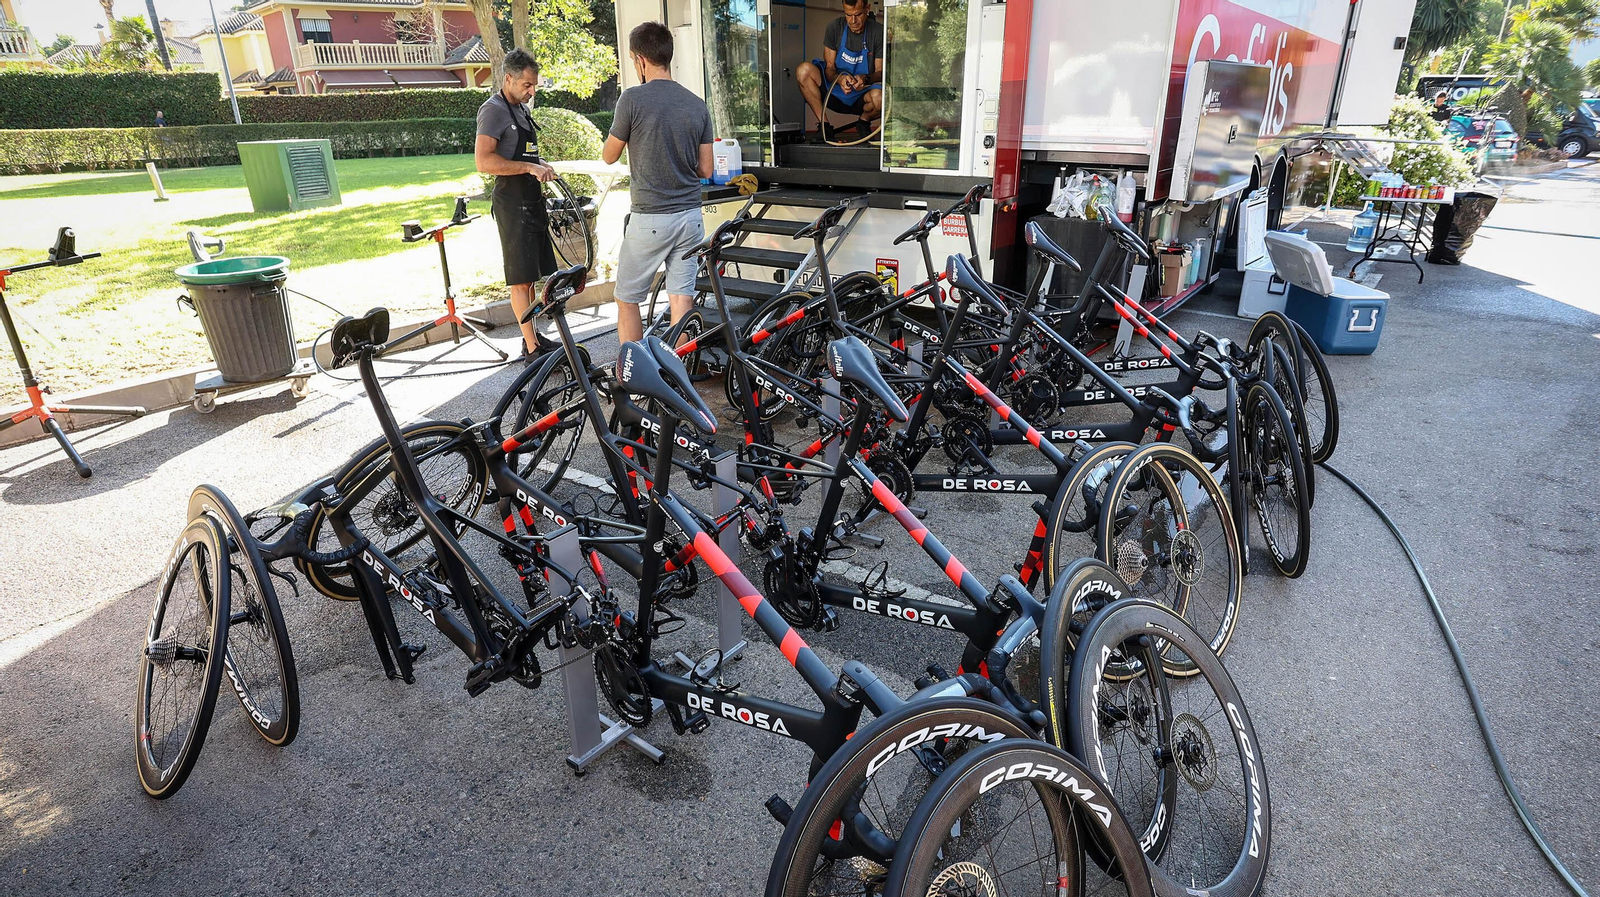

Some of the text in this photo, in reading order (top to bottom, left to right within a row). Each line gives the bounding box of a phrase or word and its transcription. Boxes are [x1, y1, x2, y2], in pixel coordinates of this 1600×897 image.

[704, 204, 717, 214] 903
[904, 321, 942, 344] DE RO
[1104, 357, 1172, 371] DE ROSA
[755, 375, 773, 391] DE
[1084, 390, 1105, 401] DE
[640, 417, 661, 435] DE
[1051, 429, 1107, 440] ROSA
[449, 474, 473, 508] CORIM
[942, 478, 1033, 492] DE ROSA
[516, 488, 539, 511] DE
[542, 505, 572, 528] RO
[362, 549, 437, 626] DE ROSA
[1072, 580, 1122, 614] CORIM
[852, 596, 955, 630] DE ROSA
[687, 691, 792, 737] DE ROSA
[866, 722, 1006, 778] CORIM
[979, 762, 1113, 829] CORIMA
[1227, 702, 1262, 858] CORIMA
[1140, 803, 1167, 853] COR
